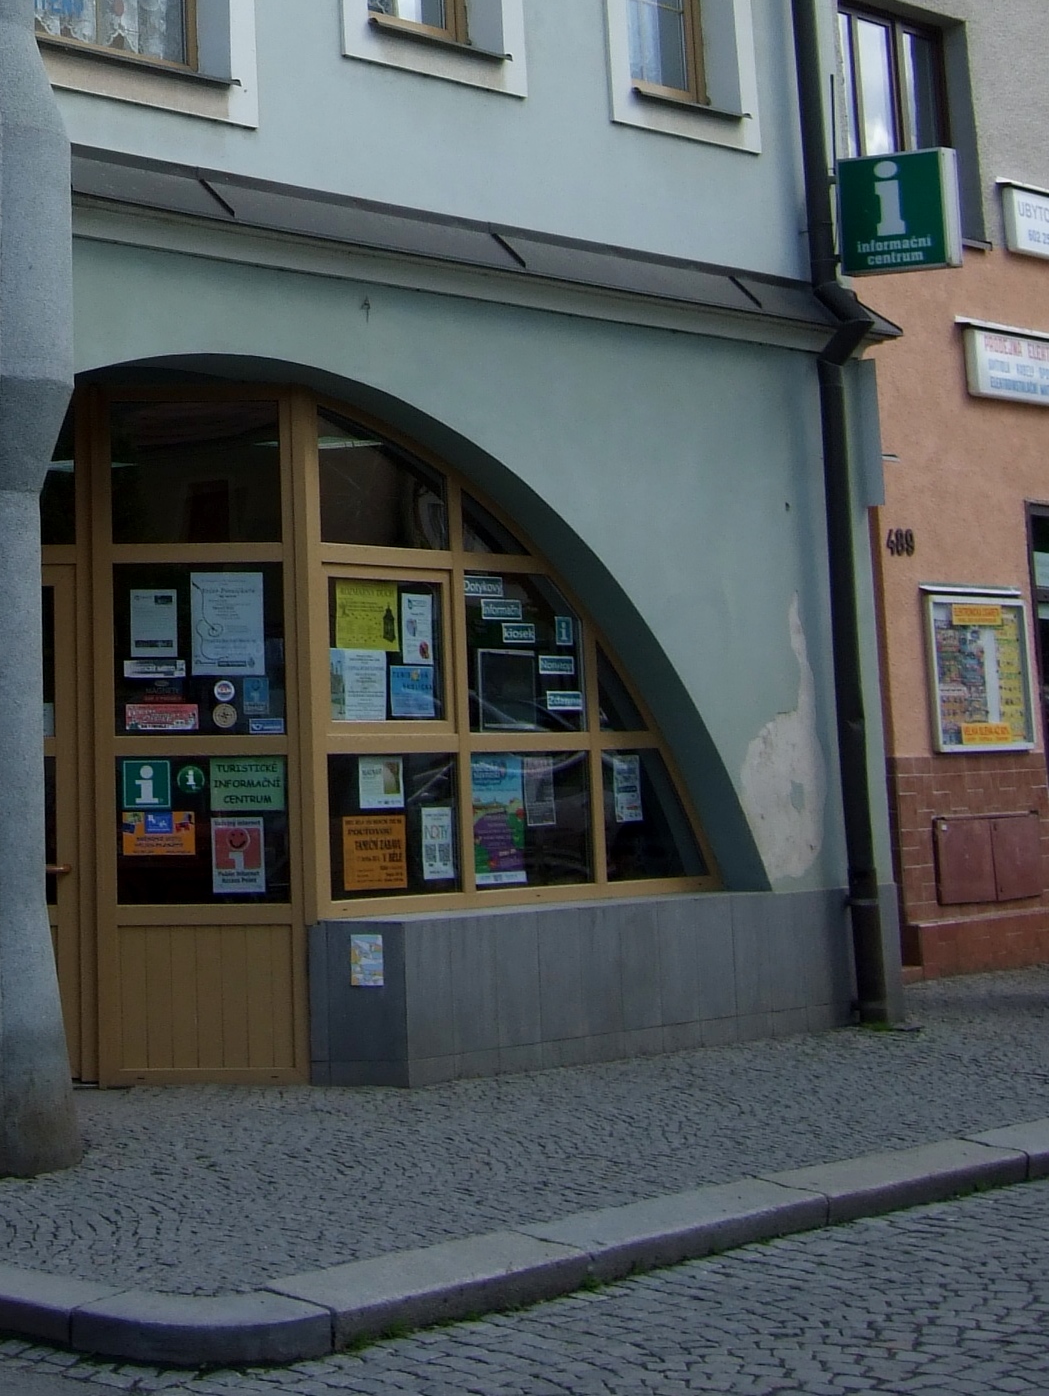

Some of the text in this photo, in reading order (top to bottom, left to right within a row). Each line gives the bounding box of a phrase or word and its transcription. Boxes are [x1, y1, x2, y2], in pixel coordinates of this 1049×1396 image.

[856, 233, 933, 254] informační
[866, 250, 925, 266] centrum
[886, 527, 915, 557] 489
[215, 762, 279, 774] TURISTICKÉ
[212, 777, 282, 789] INFORMAČNÍ
[223, 794, 273, 805] CENTRUM
